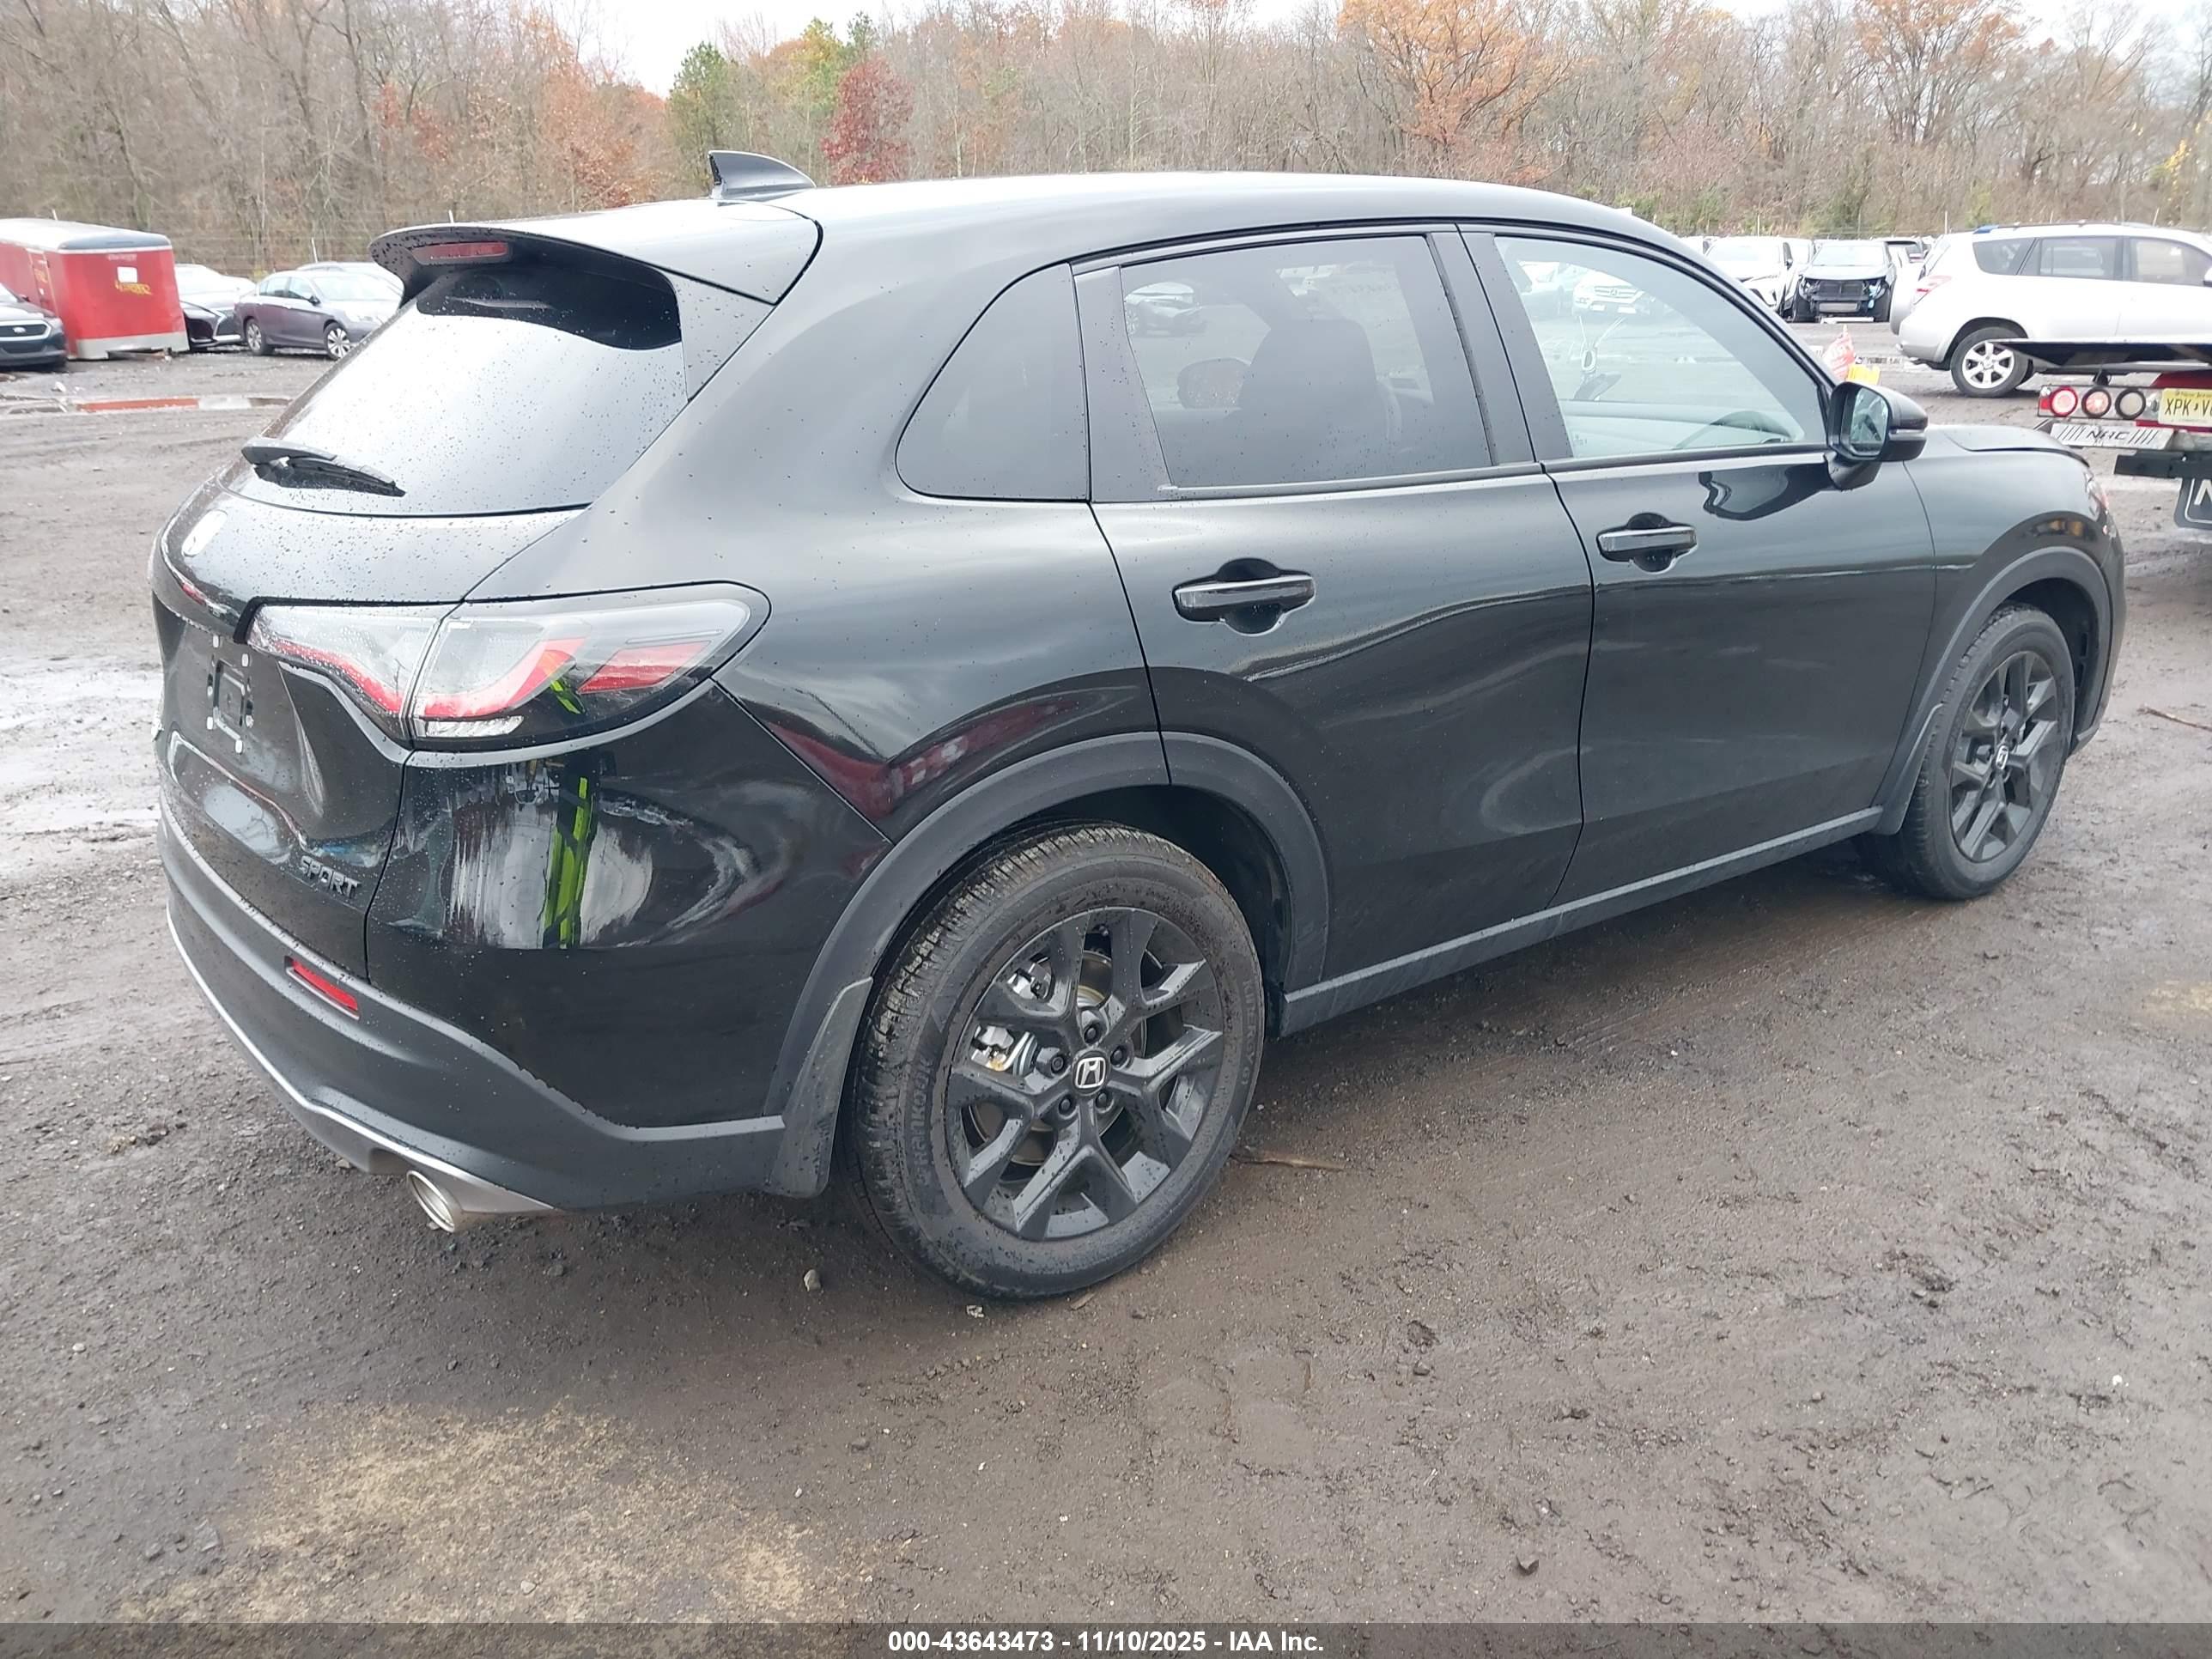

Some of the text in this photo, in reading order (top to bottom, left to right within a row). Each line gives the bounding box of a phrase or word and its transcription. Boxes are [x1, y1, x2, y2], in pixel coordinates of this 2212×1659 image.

[2165, 398, 2212, 416] XPK V
[299, 855, 361, 897] SPORT
